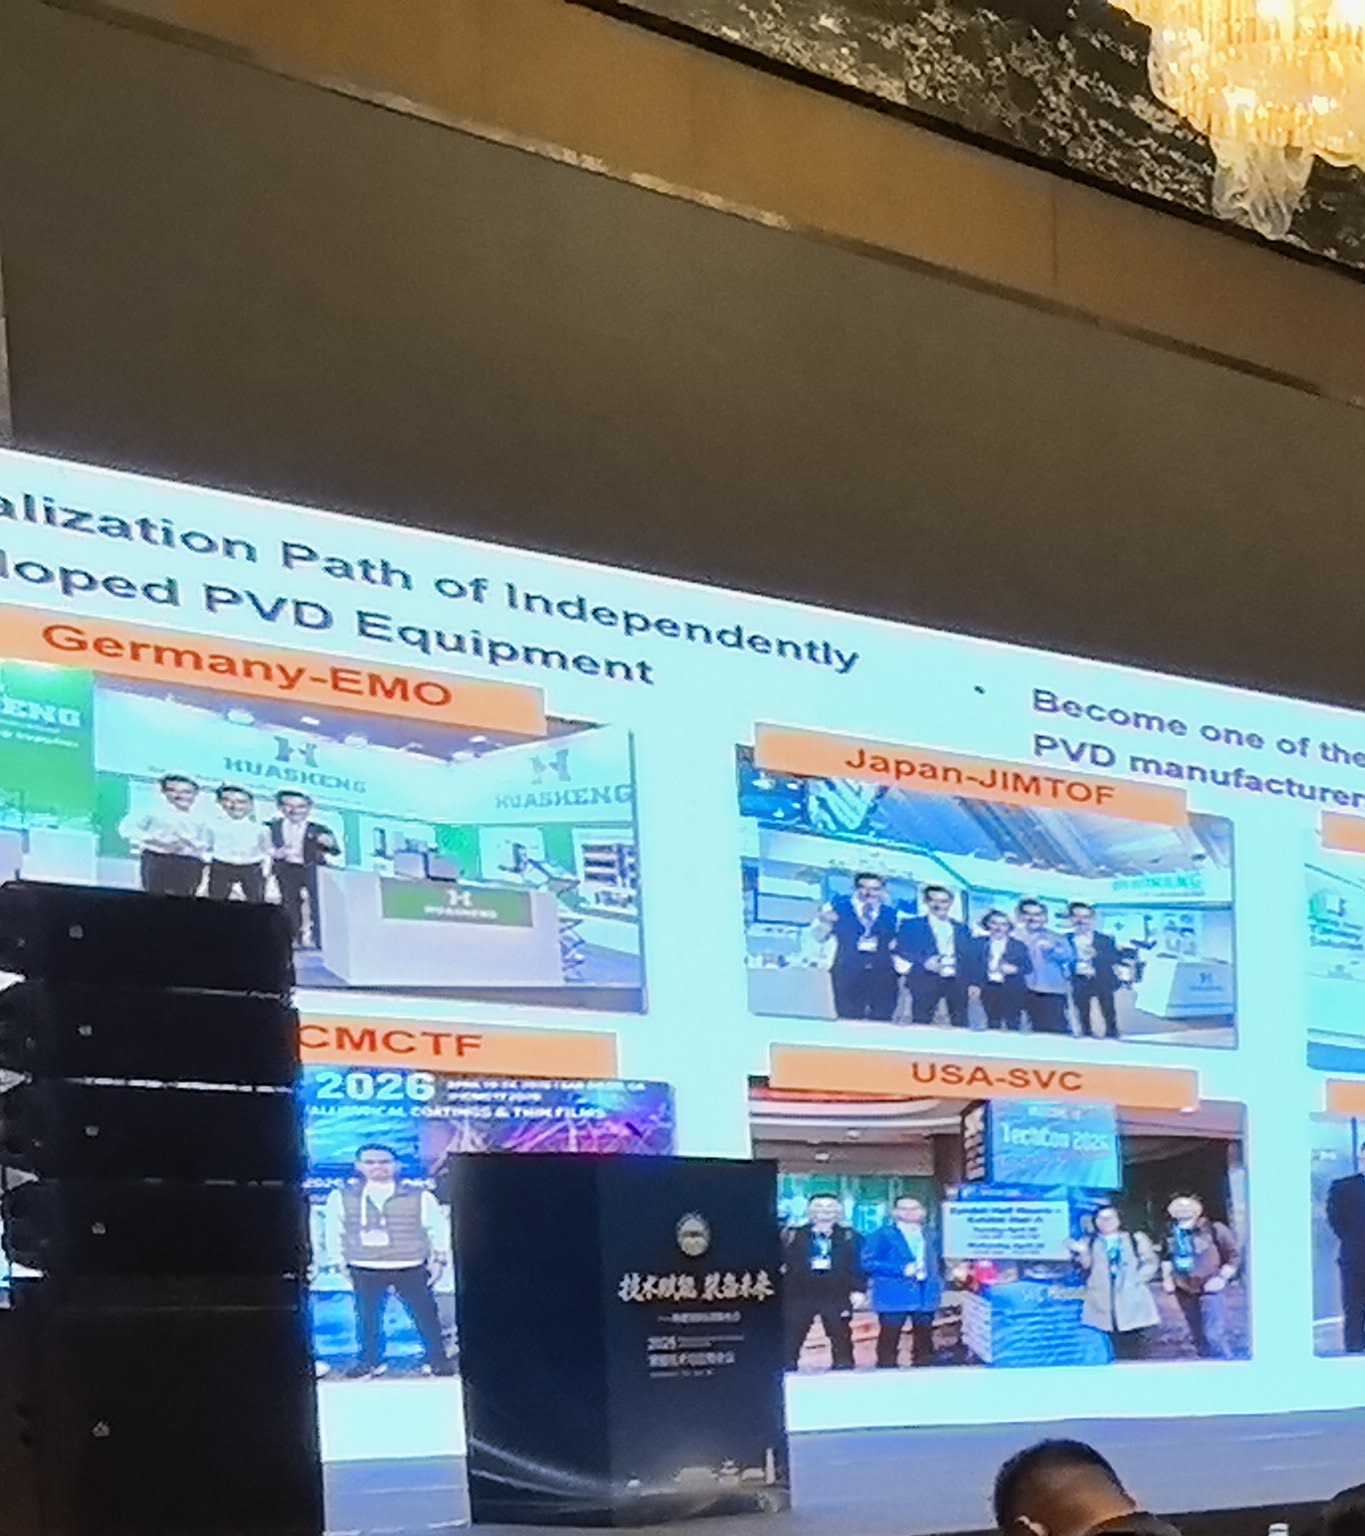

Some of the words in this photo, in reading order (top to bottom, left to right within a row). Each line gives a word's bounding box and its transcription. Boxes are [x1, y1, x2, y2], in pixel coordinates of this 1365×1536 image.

[203, 582, 334, 631] PVD
[356, 609, 656, 687] Equipment
[281, 539, 413, 592] Path
[434, 575, 489, 604] of
[508, 583, 861, 675] Independently
[42, 623, 454, 708] Germany-EMO
[1032, 687, 1188, 738] Become
[1200, 722, 1265, 751] one
[1276, 735, 1310, 758] of
[1032, 733, 1117, 768] PVD
[845, 748, 1117, 805] Japan-JIMTOF
[315, 1072, 436, 1101] 2026
[912, 1062, 1083, 1092] USA-SVC
